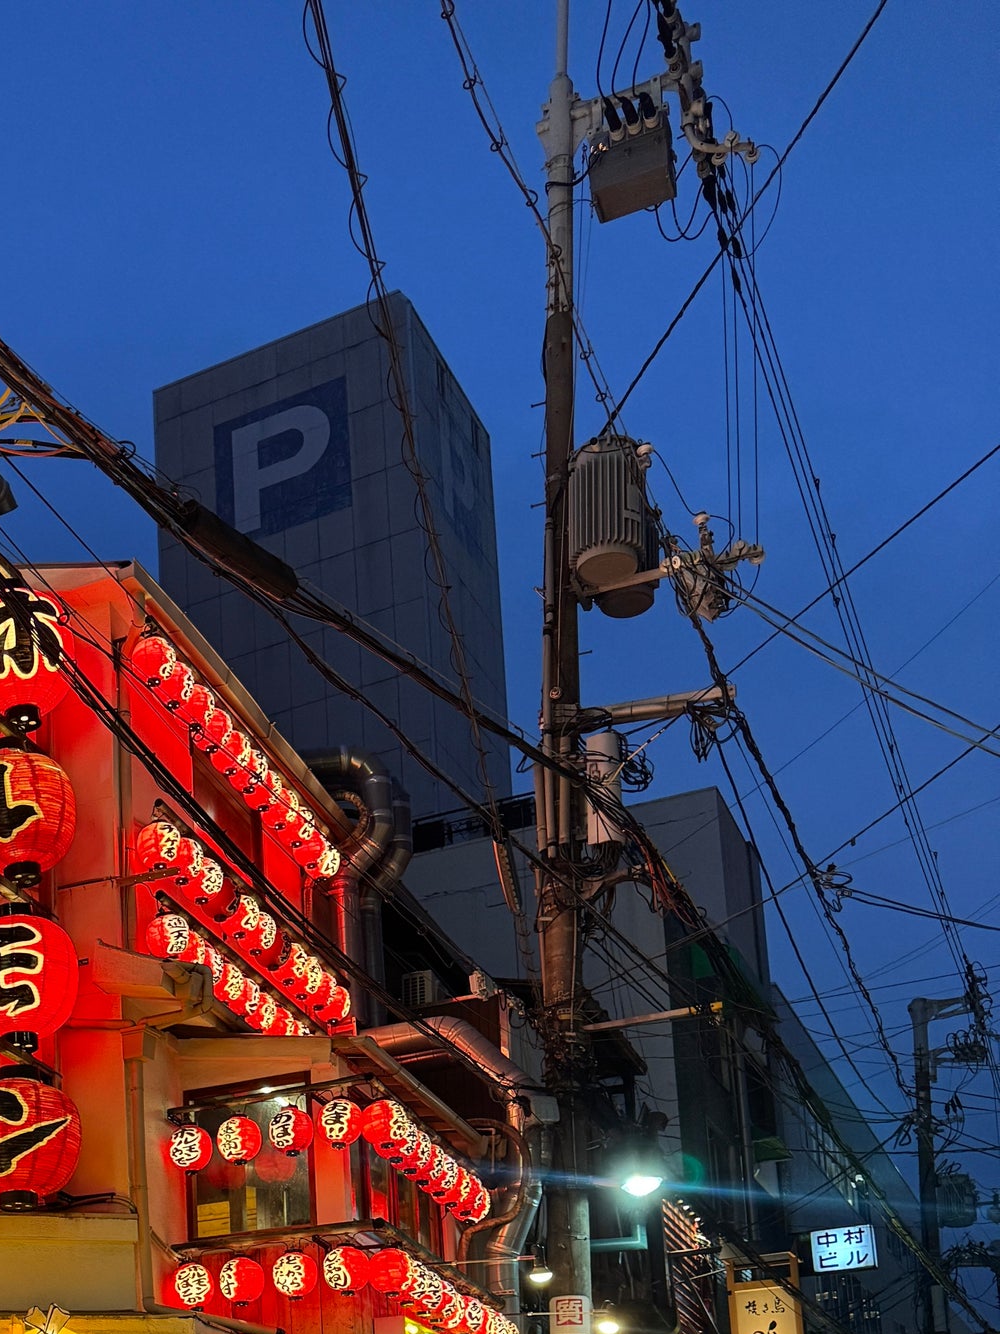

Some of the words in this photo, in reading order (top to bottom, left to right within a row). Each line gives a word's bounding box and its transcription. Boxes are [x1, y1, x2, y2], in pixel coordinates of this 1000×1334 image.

[232, 404, 331, 534] P
[271, 1111, 294, 1148] あほか
[816, 1227, 865, 1247] 中村
[818, 1251, 869, 1268] ビル
[556, 1300, 583, 1325] 質
[744, 1297, 787, 1316] 焼き鳥
